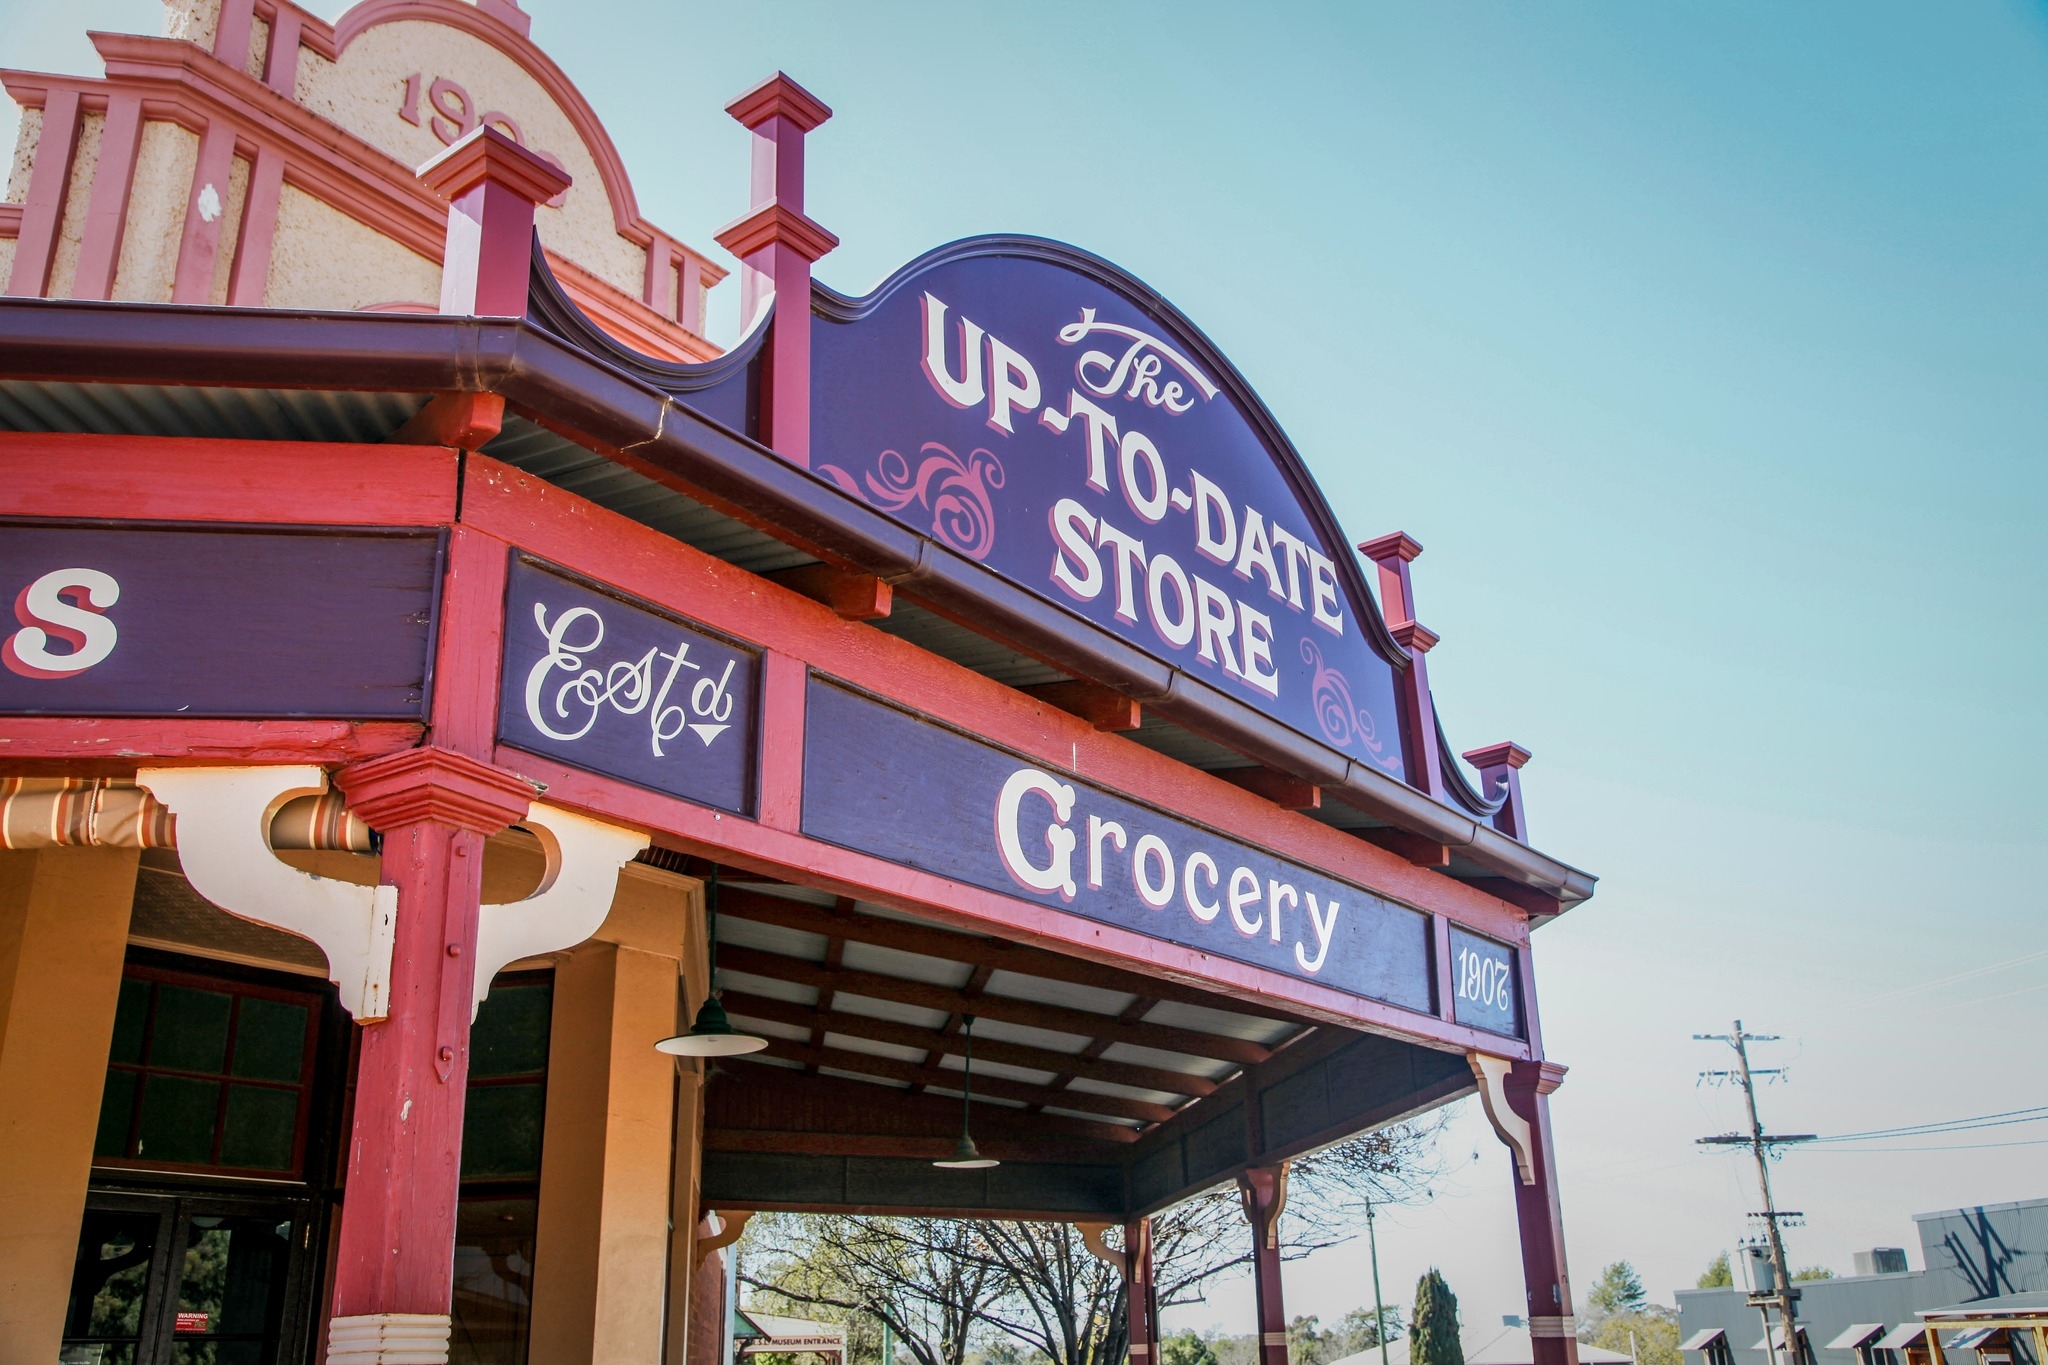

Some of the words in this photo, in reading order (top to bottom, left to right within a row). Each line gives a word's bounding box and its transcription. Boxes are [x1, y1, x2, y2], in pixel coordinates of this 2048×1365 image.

[1058, 306, 1220, 413] The
[920, 290, 1344, 637] UP-TO-DATE
[1049, 497, 1279, 698] STORE
[525, 602, 736, 757] Estd
[995, 768, 1340, 974] Grocery
[1458, 946, 1510, 1011] 1907
[803, 1337, 840, 1345] ENTRANCE
